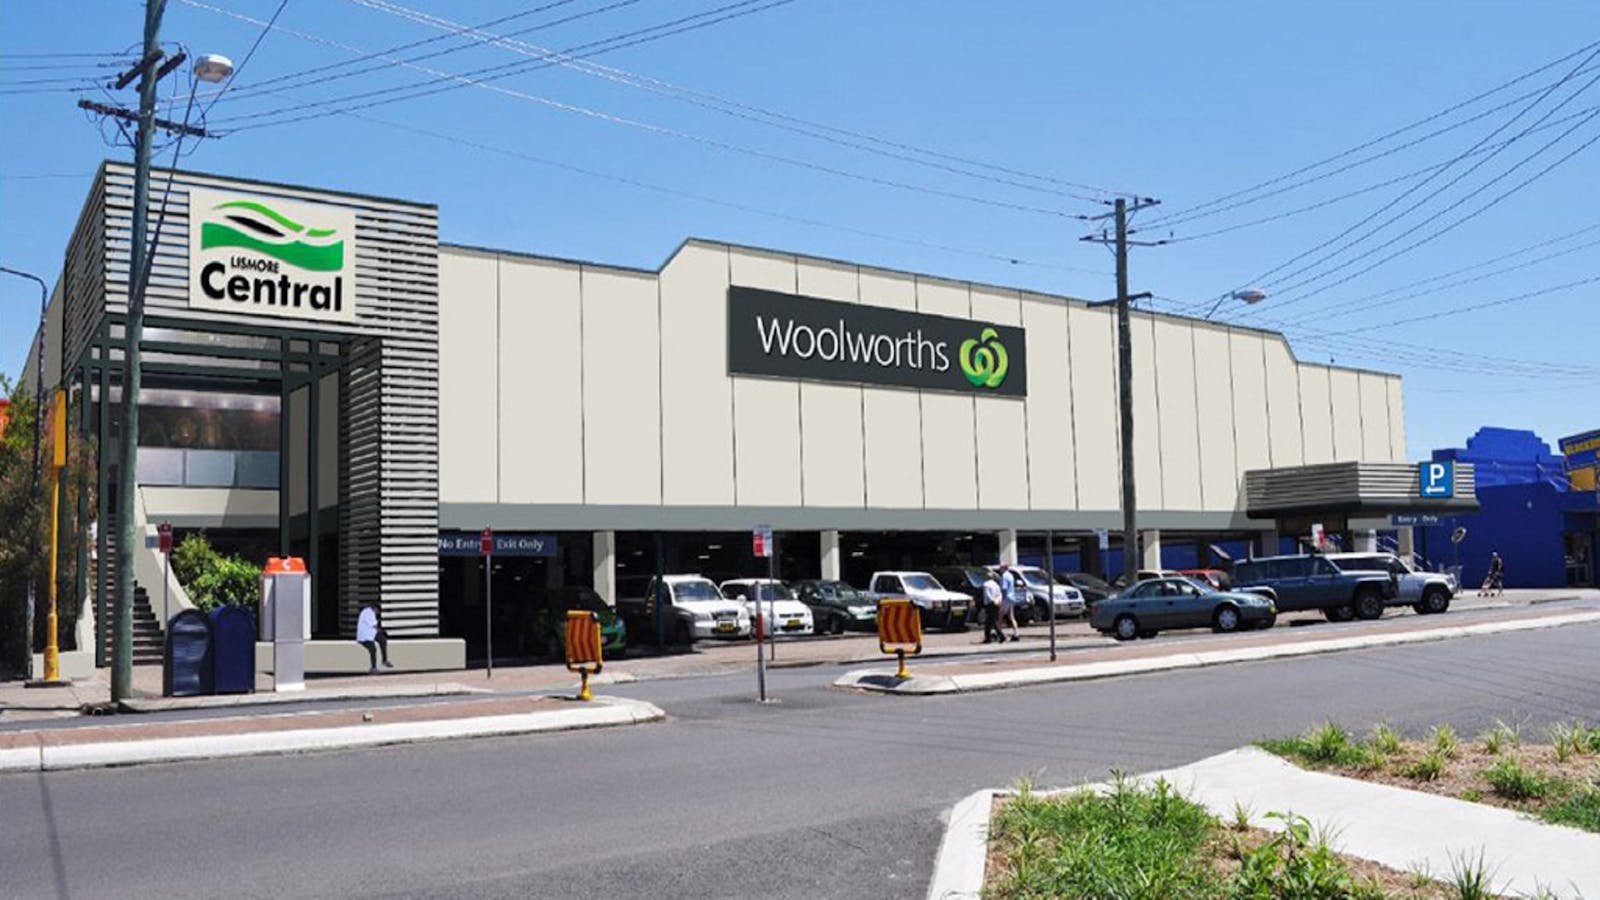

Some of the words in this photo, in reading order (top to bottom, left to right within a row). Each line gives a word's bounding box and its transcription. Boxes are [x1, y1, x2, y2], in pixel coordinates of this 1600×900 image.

[230, 256, 280, 274] LISMORE
[201, 261, 342, 312] Central
[756, 315, 949, 371] Woolworths
[1430, 463, 1445, 486] P
[438, 539, 454, 549] No
[497, 539, 518, 549] Exit
[520, 538, 545, 552] Only
